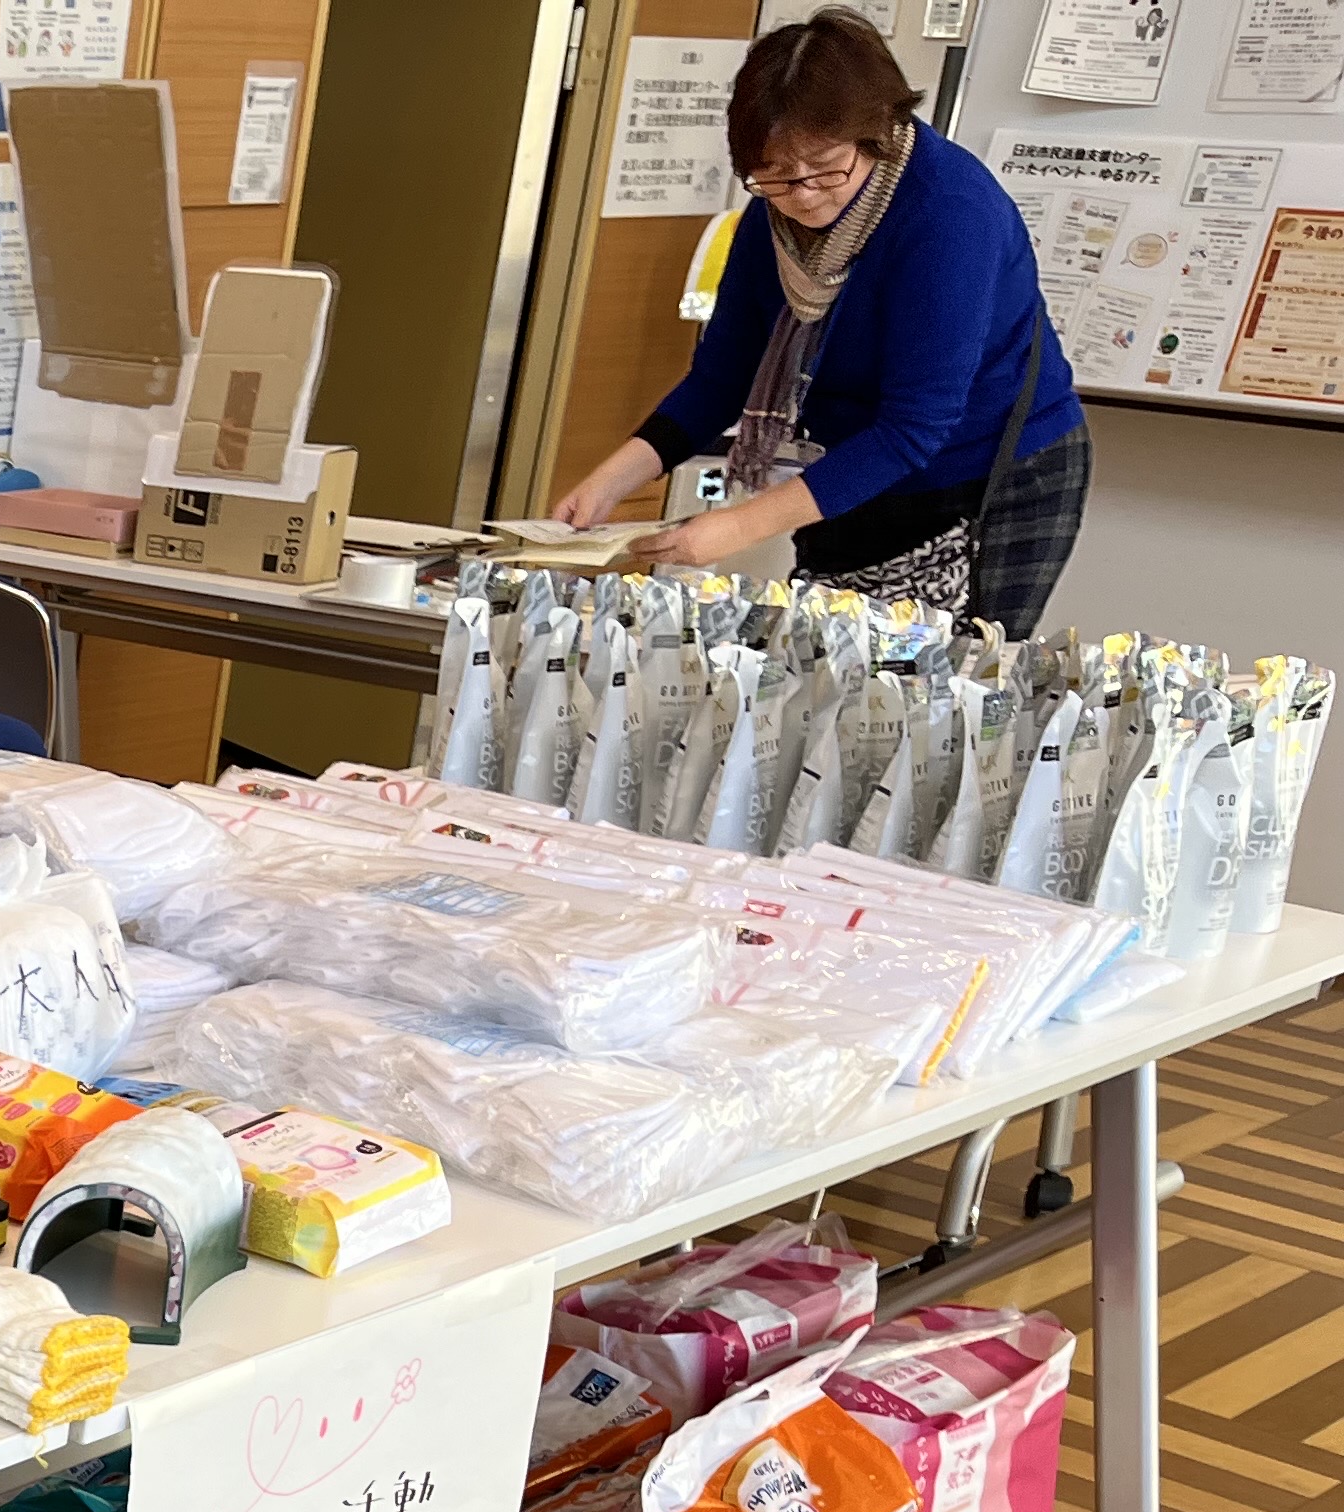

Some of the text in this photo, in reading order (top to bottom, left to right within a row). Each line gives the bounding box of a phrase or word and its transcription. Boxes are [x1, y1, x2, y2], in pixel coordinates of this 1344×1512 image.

[1001, 160, 1161, 186] 行ったイベント・ゆるカフェ
[281, 515, 305, 575] S-8113
